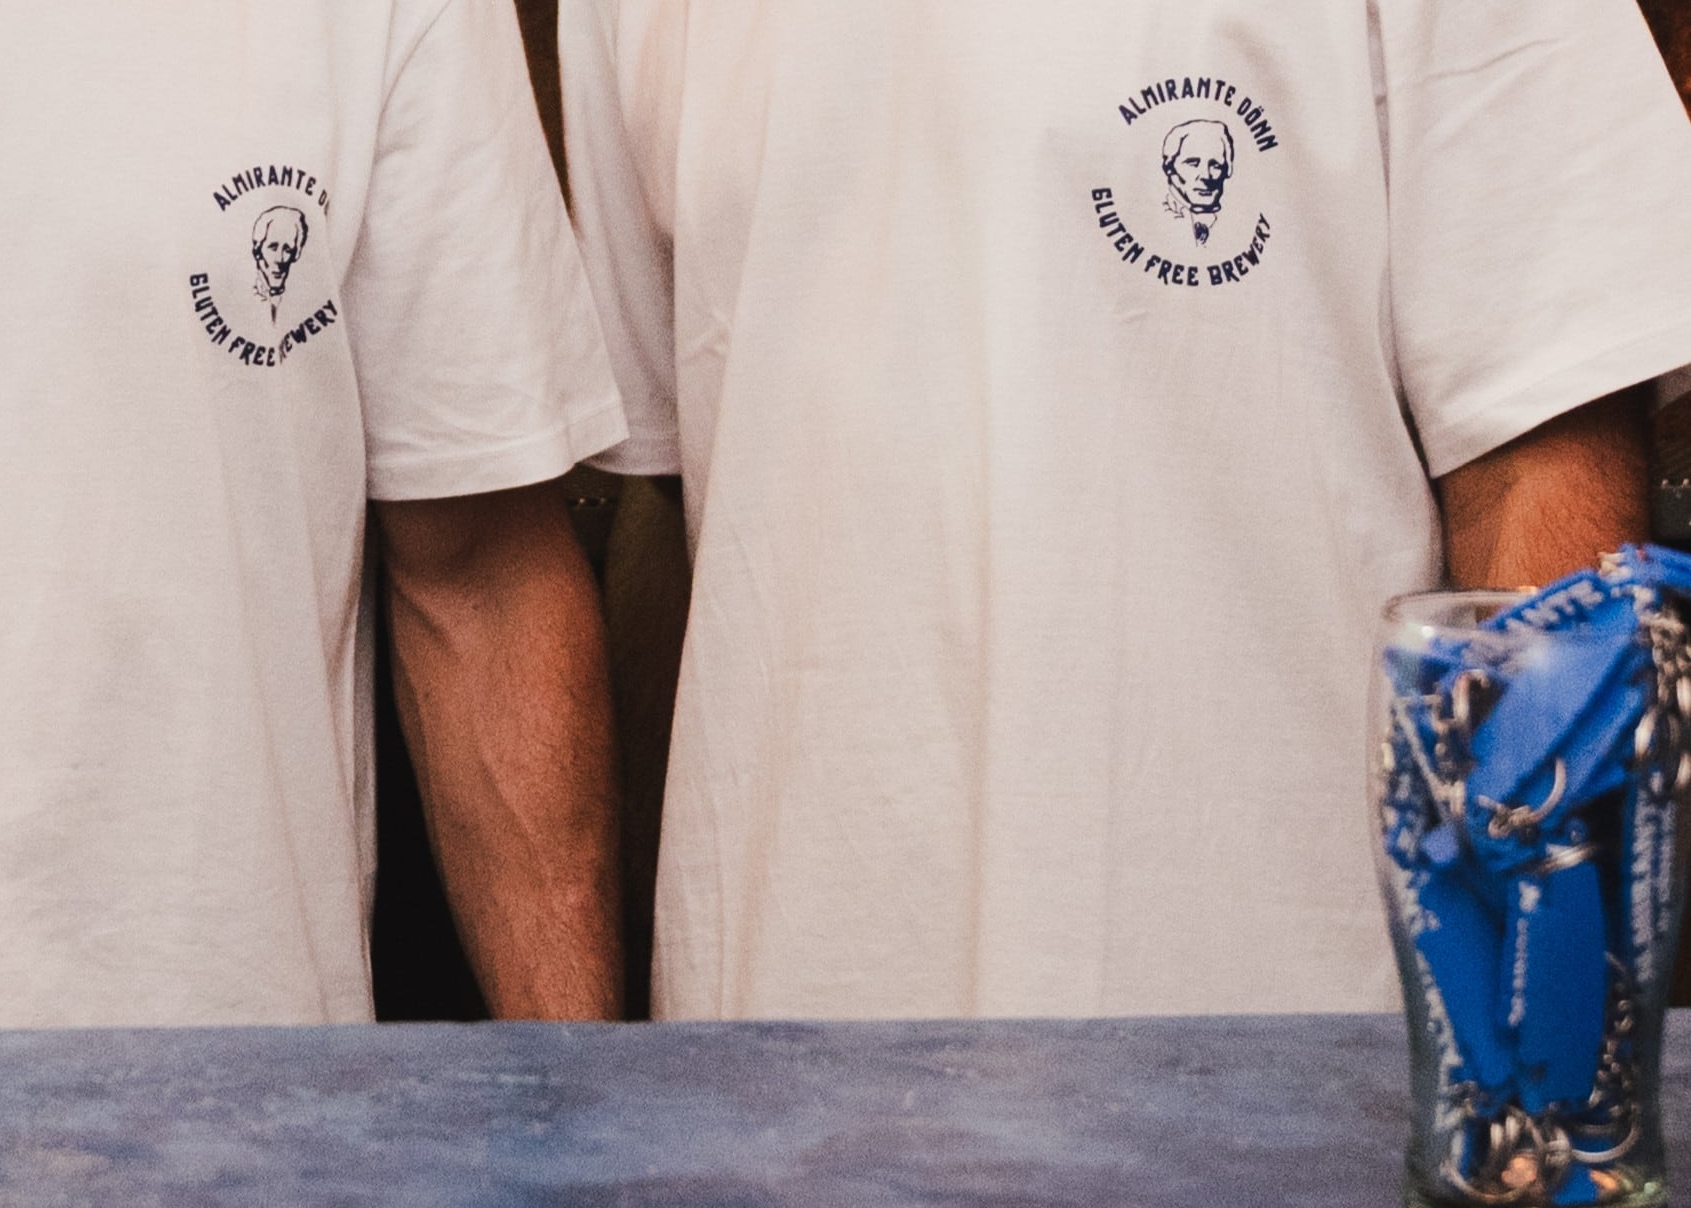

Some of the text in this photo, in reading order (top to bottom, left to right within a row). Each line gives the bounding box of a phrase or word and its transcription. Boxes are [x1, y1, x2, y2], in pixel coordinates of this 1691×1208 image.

[1117, 76, 1279, 152] ALMIRANTE DÖNN
[212, 164, 317, 212] ALMIRANTE
[1091, 187, 1271, 287] GLUTEN FREE BREWERY
[189, 272, 232, 345] GLUTEN
[227, 335, 276, 367] FREE
